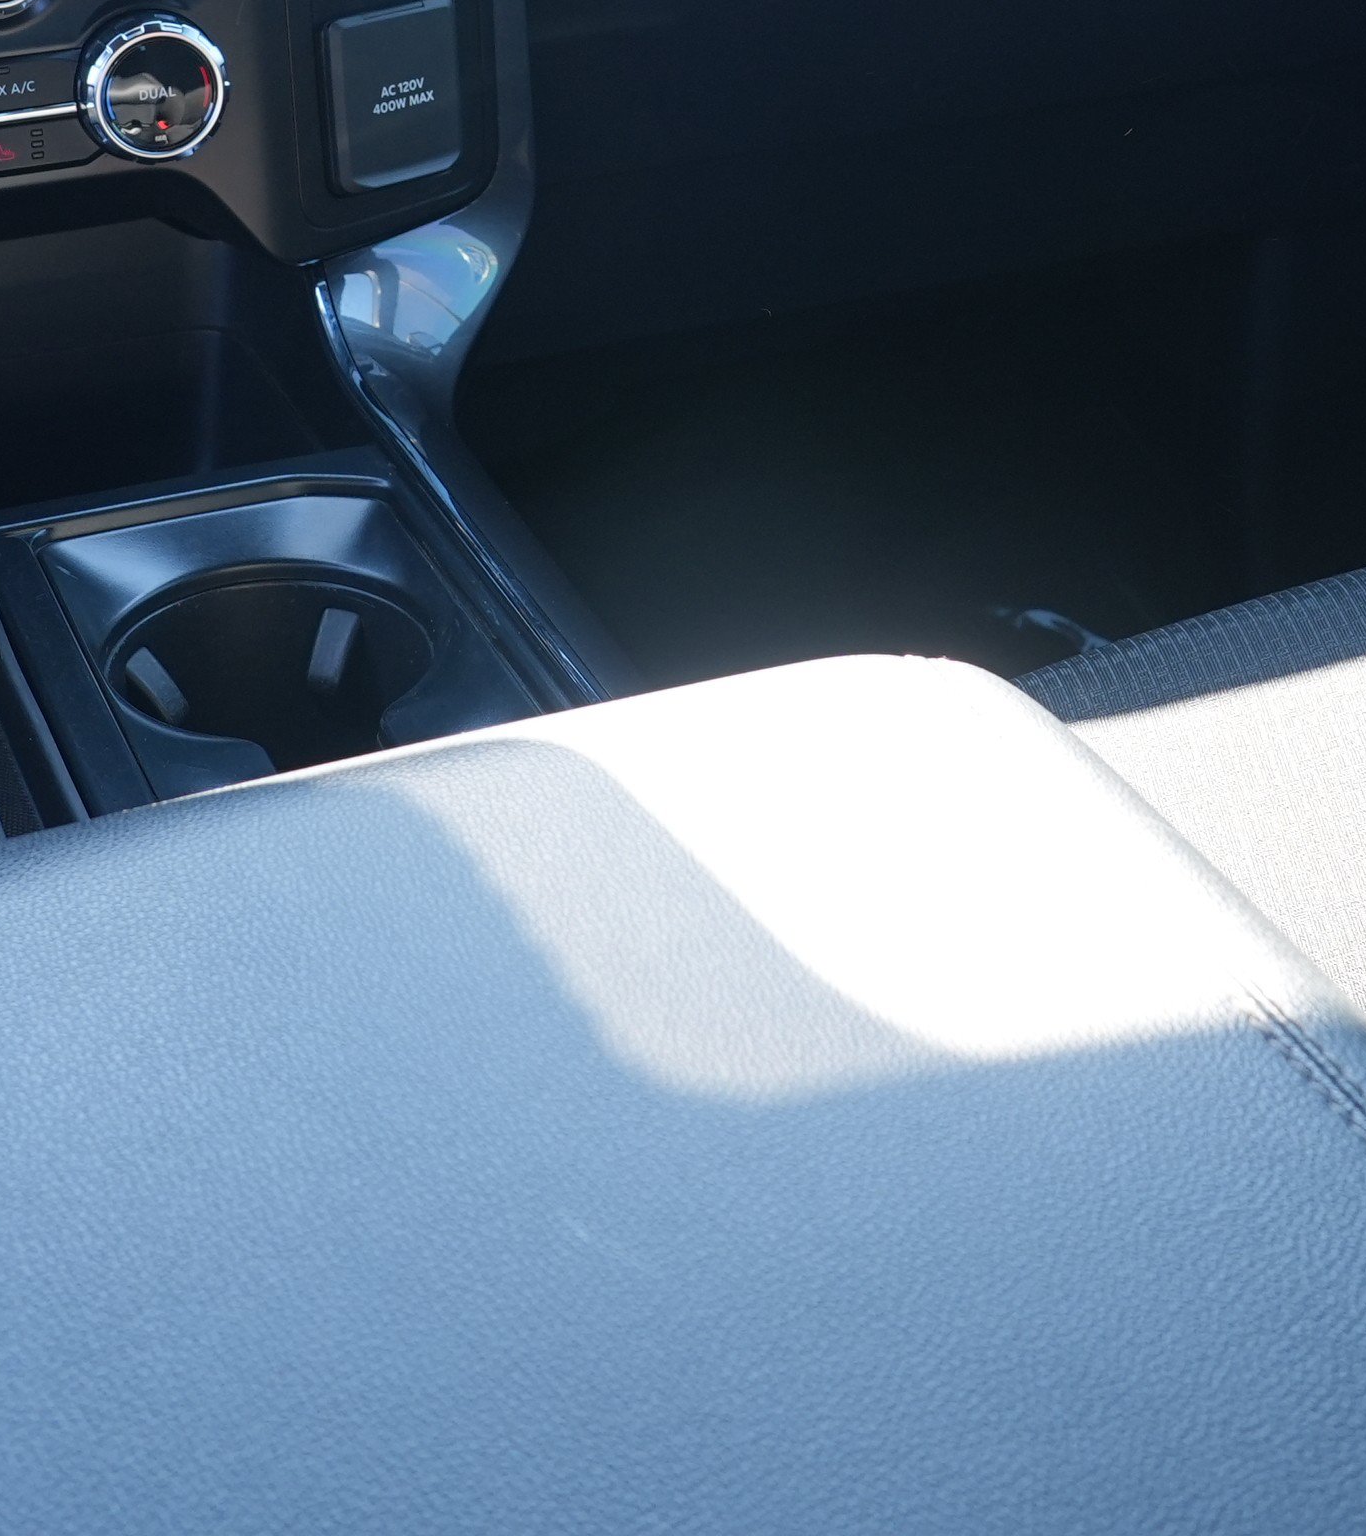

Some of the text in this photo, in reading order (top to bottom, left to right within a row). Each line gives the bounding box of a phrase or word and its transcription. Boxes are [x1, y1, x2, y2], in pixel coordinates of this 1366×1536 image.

[10, 80, 36, 96] A/C
[139, 86, 176, 100] DUAL
[380, 77, 425, 98] AC 120V
[373, 89, 435, 115] 400W MAX
